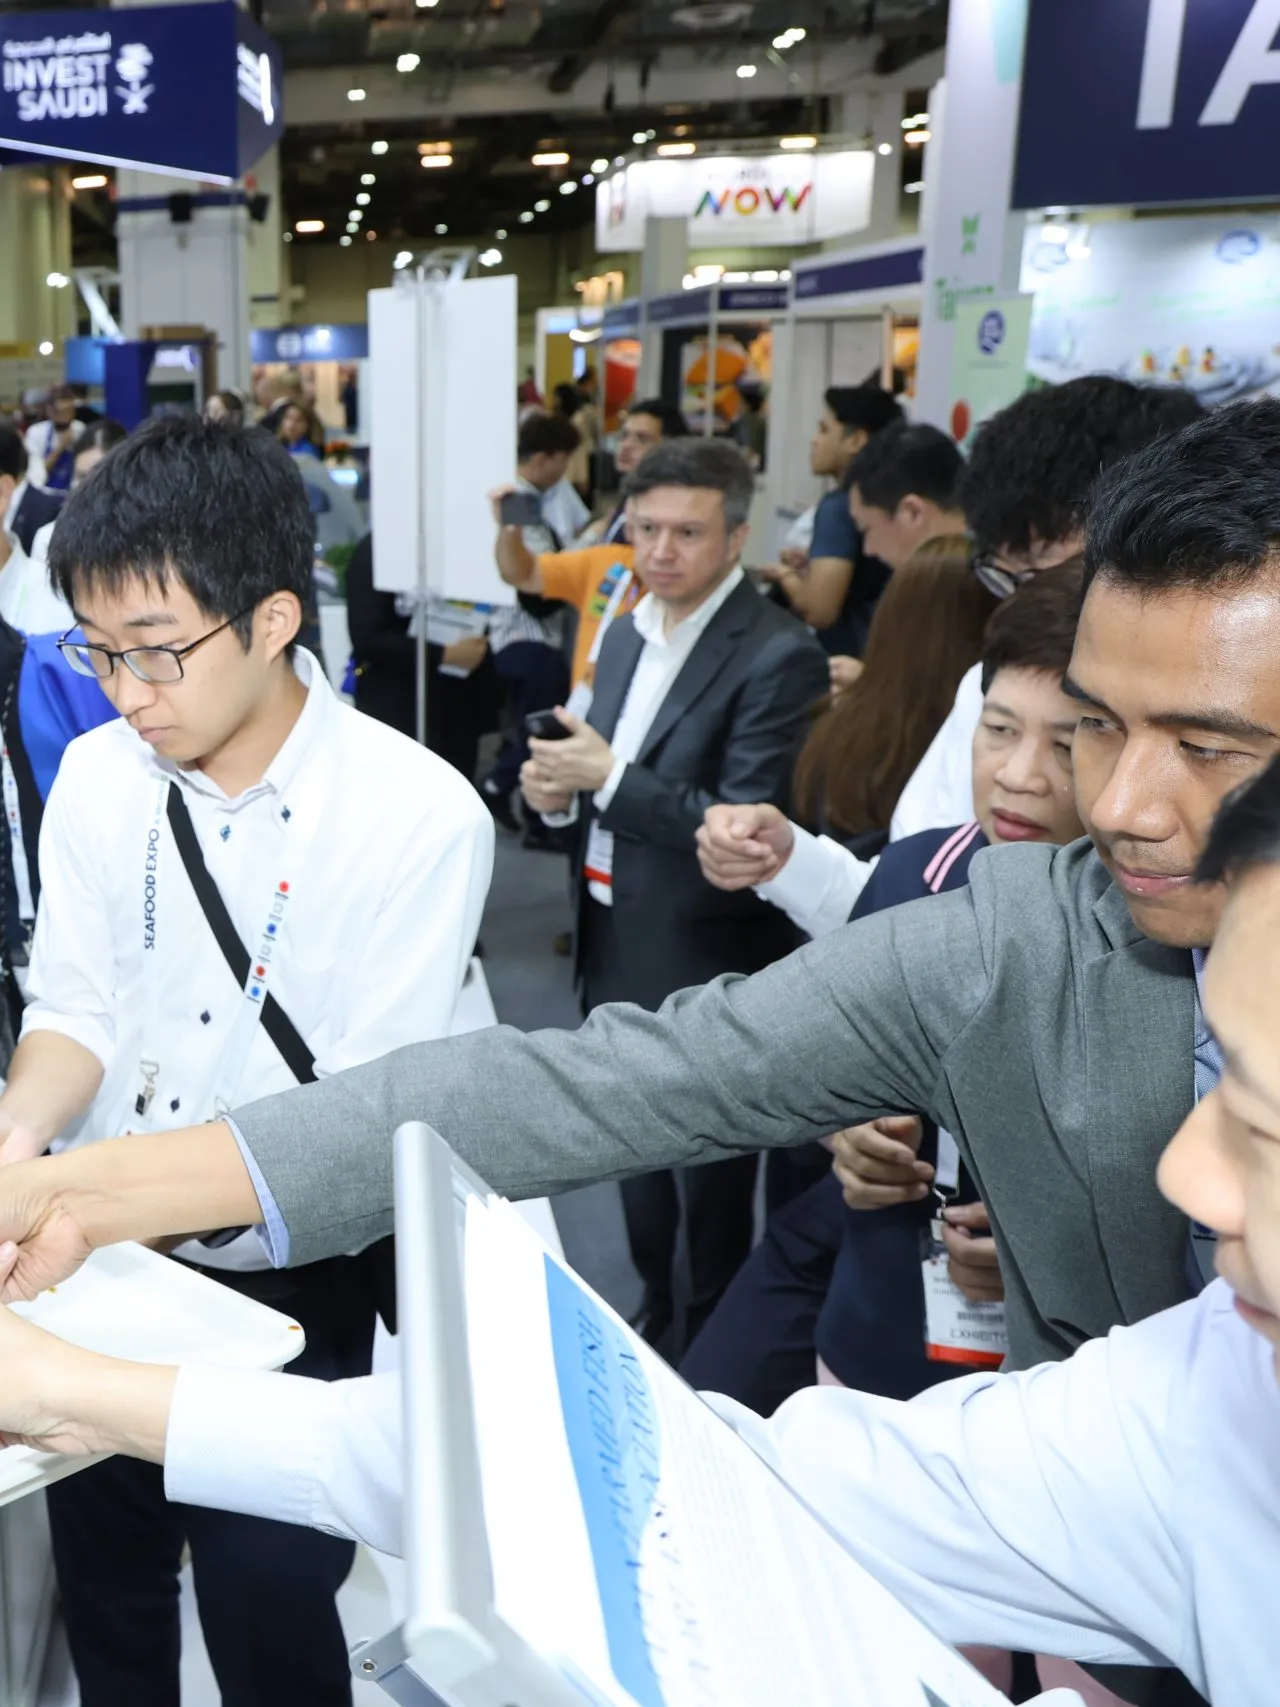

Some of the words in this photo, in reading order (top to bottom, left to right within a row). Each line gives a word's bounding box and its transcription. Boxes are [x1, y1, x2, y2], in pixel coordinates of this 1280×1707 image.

[3, 52, 111, 92] INVEST
[17, 85, 108, 121] SAUDI
[694, 181, 812, 217] NOW
[145, 828, 160, 872] EXPO
[144, 874, 156, 951] SEAFOOD
